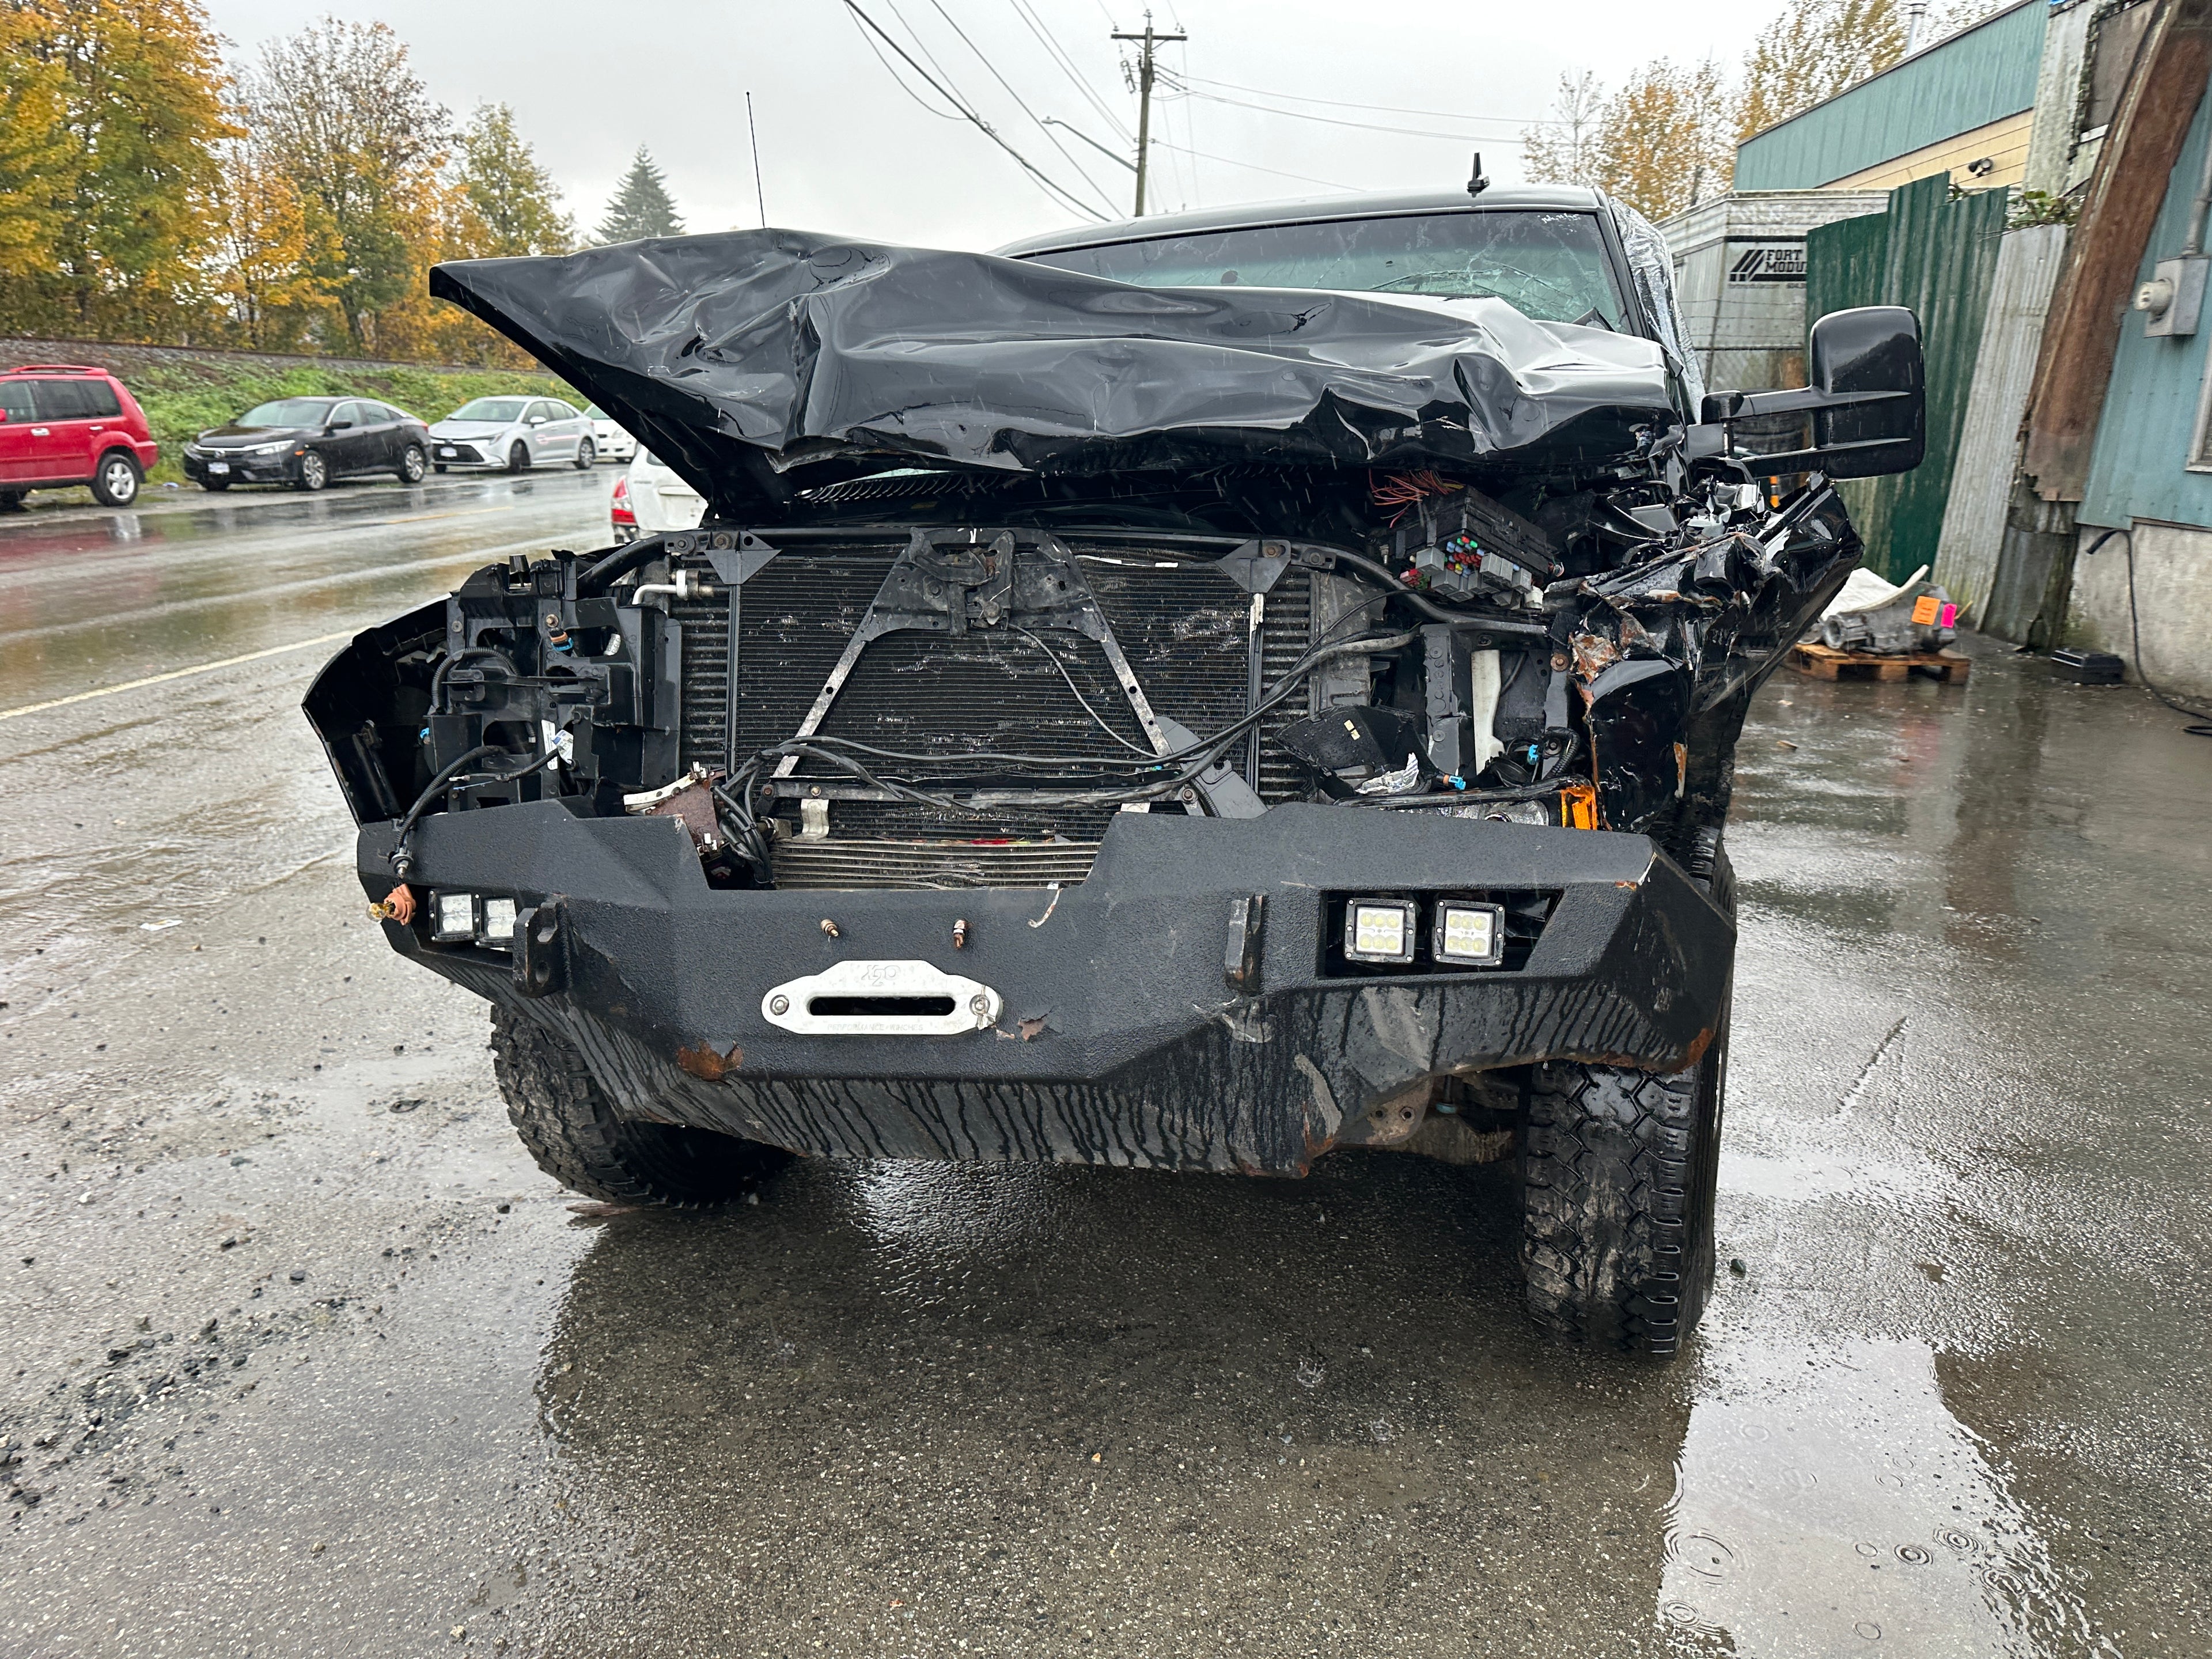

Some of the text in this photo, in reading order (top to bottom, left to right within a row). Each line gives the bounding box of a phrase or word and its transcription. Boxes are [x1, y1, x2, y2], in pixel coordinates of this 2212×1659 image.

[1766, 249, 1803, 260] FORT
[1764, 261, 1807, 272] MODU
[827, 1023, 924, 1031] PERFORMANCE WINCHES
